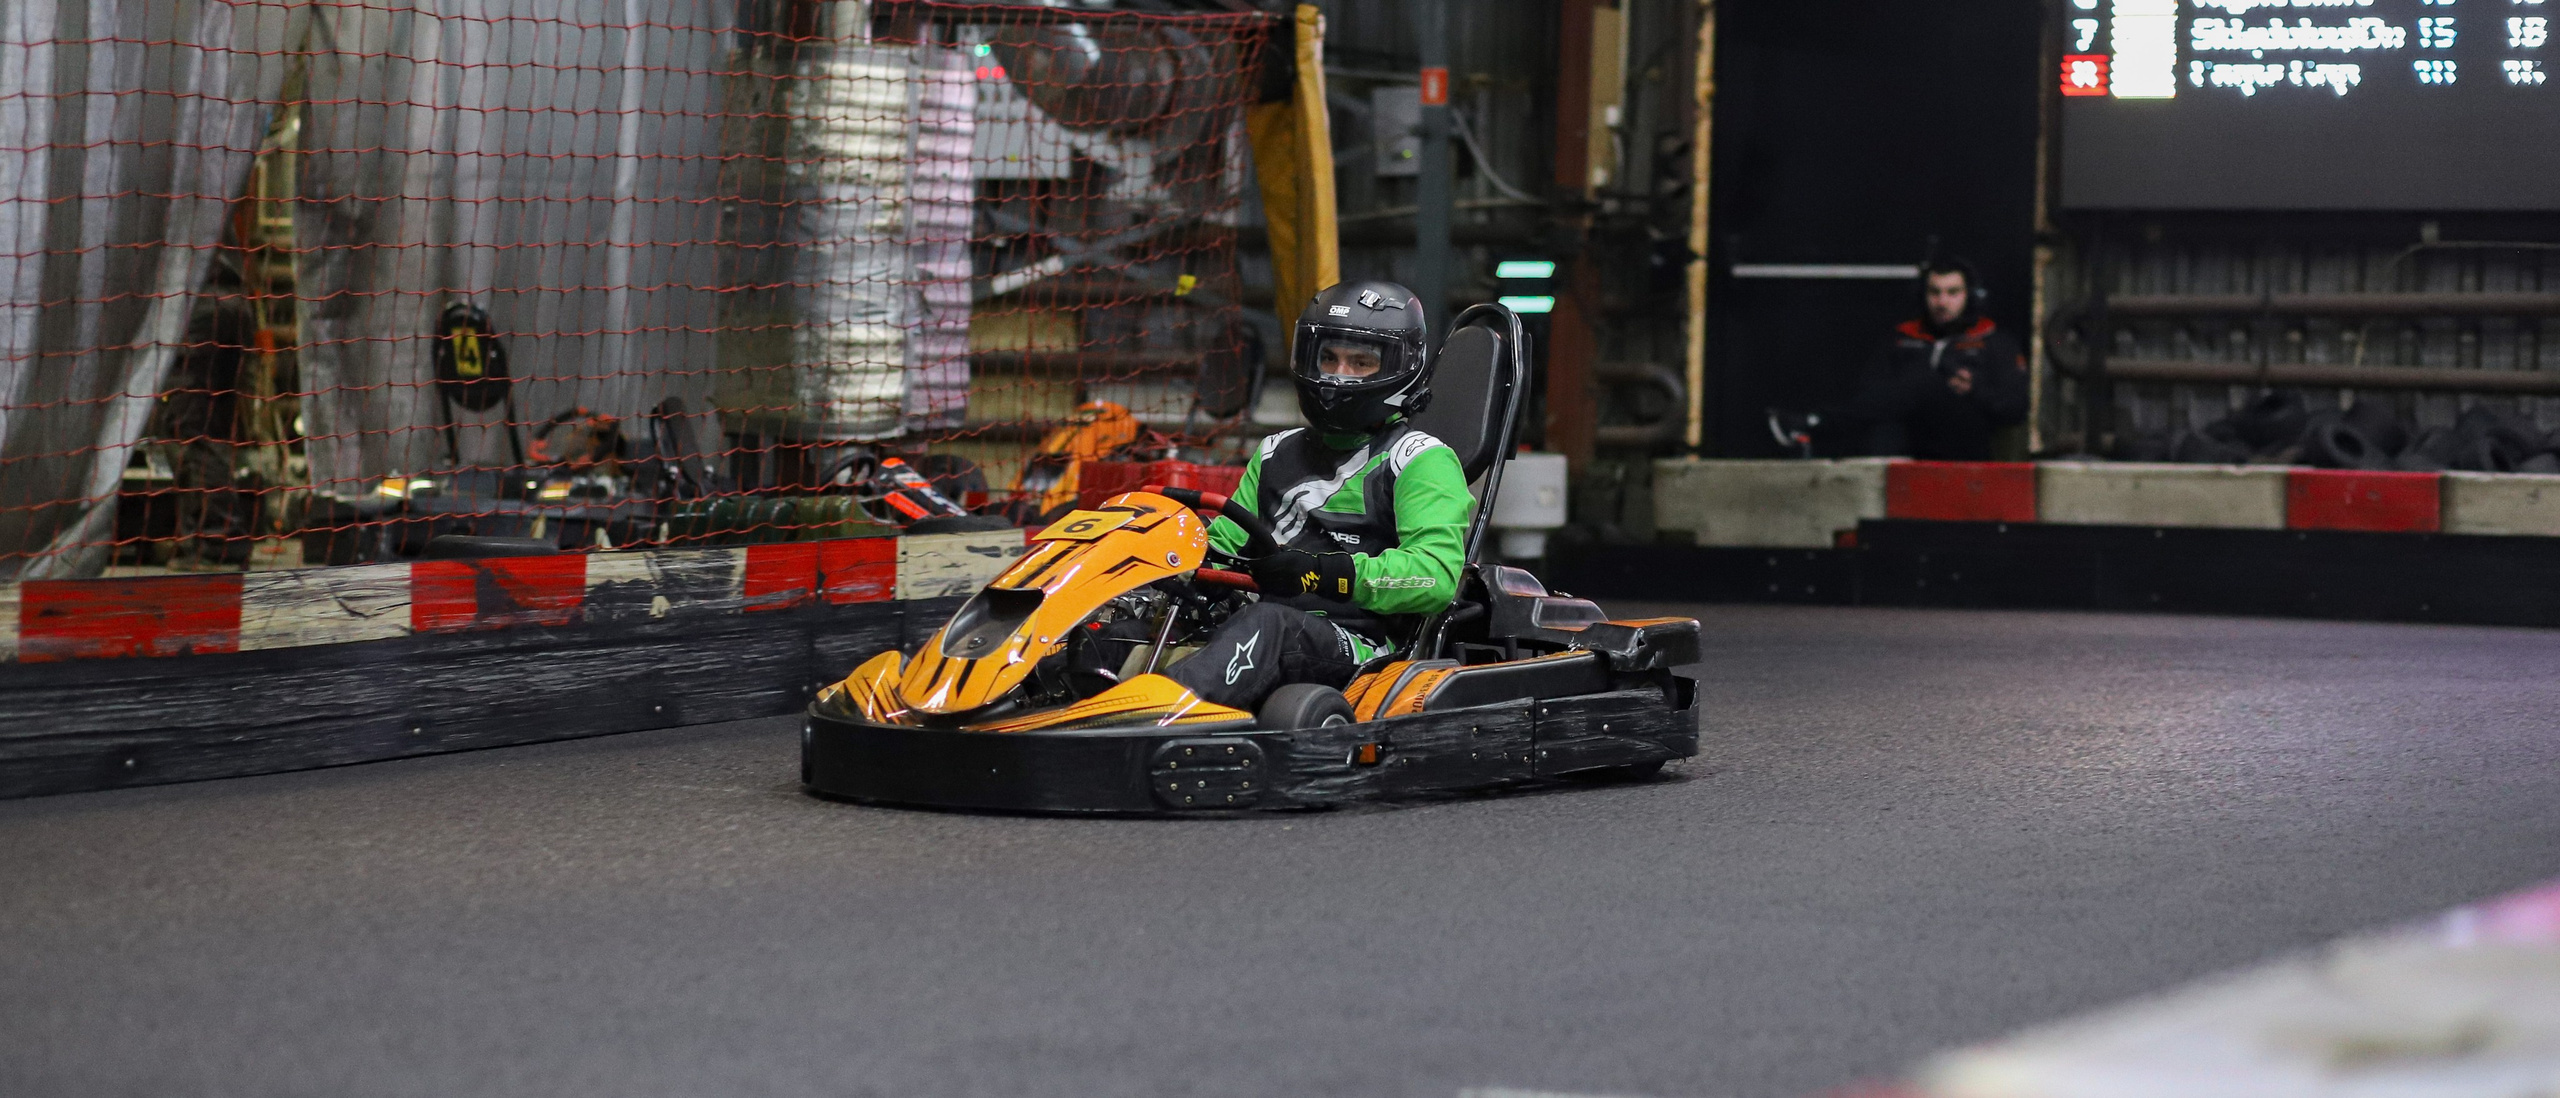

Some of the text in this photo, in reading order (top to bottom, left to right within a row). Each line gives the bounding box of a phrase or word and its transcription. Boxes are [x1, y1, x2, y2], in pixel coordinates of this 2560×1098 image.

[2072, 18, 2099, 51] 7
[1329, 306, 1350, 316] OMP
[1063, 518, 1103, 534] 6
